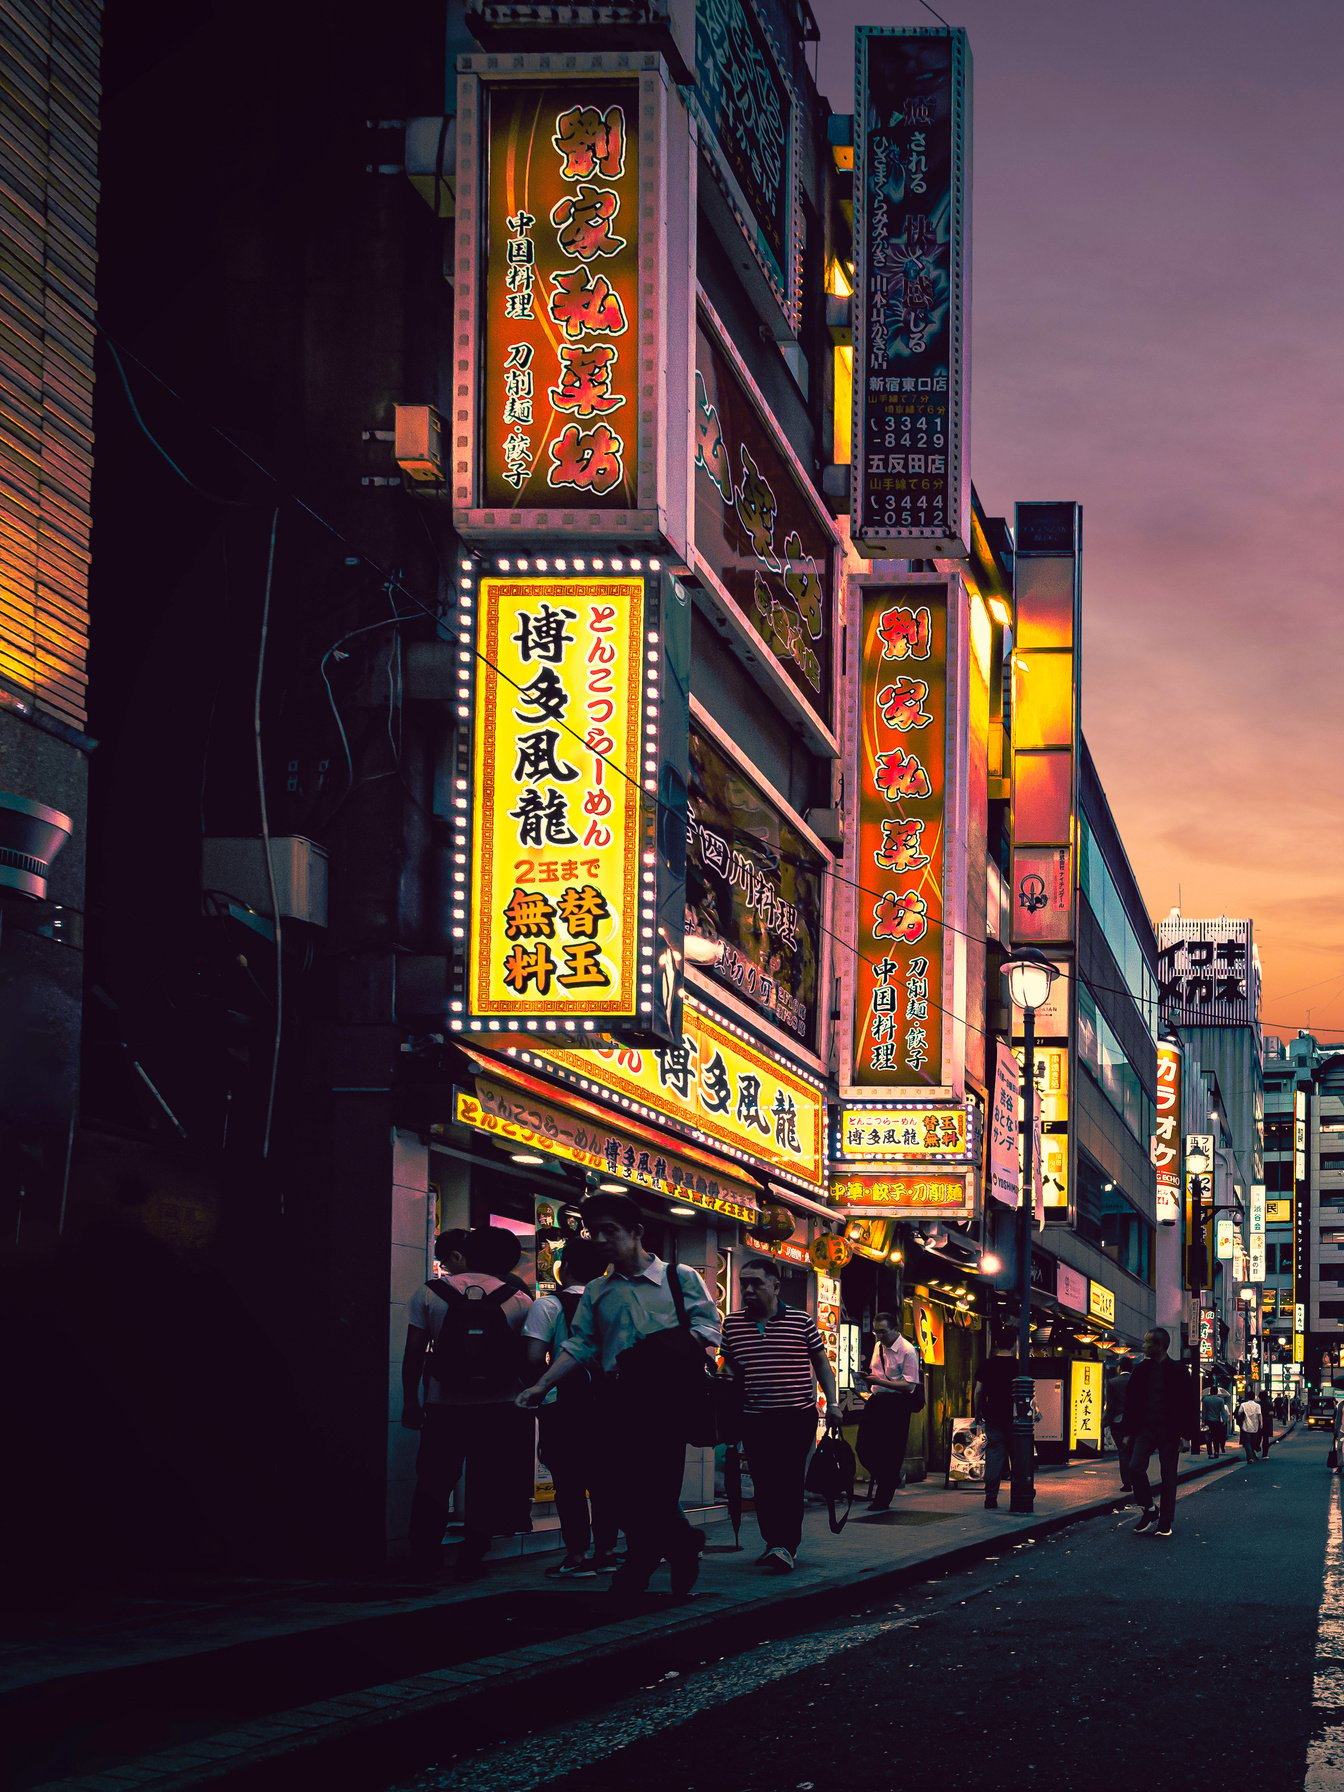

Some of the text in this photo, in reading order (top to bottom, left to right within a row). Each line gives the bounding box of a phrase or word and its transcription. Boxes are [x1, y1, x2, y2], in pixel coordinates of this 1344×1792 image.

[502, 211, 535, 489] 中国料理 刀削麺・餃子
[868, 376, 948, 392] 新宿東口店
[885, 417, 942, 431] 3341
[867, 454, 946, 474] 五反田店
[885, 495, 943, 509] 3444
[508, 603, 580, 849] 博多風龍
[581, 605, 617, 850] とんこつらーめん
[513, 857, 602, 885] 2玉まで
[1157, 975, 1248, 1004] メガネ
[870, 957, 898, 1074] 中国料理
[904, 956, 930, 1072] 刀削麺・餃子
[653, 1032, 803, 1156] 博多風龍
[1000, 1087, 1014, 1113] 渋谷
[848, 1117, 918, 1127] とんこつらーめん
[1152, 1057, 1177, 1167] カラオケ
[846, 1127, 920, 1147] 博多風龍
[829, 1182, 964, 1202] 中華・餃子・刀削麺
